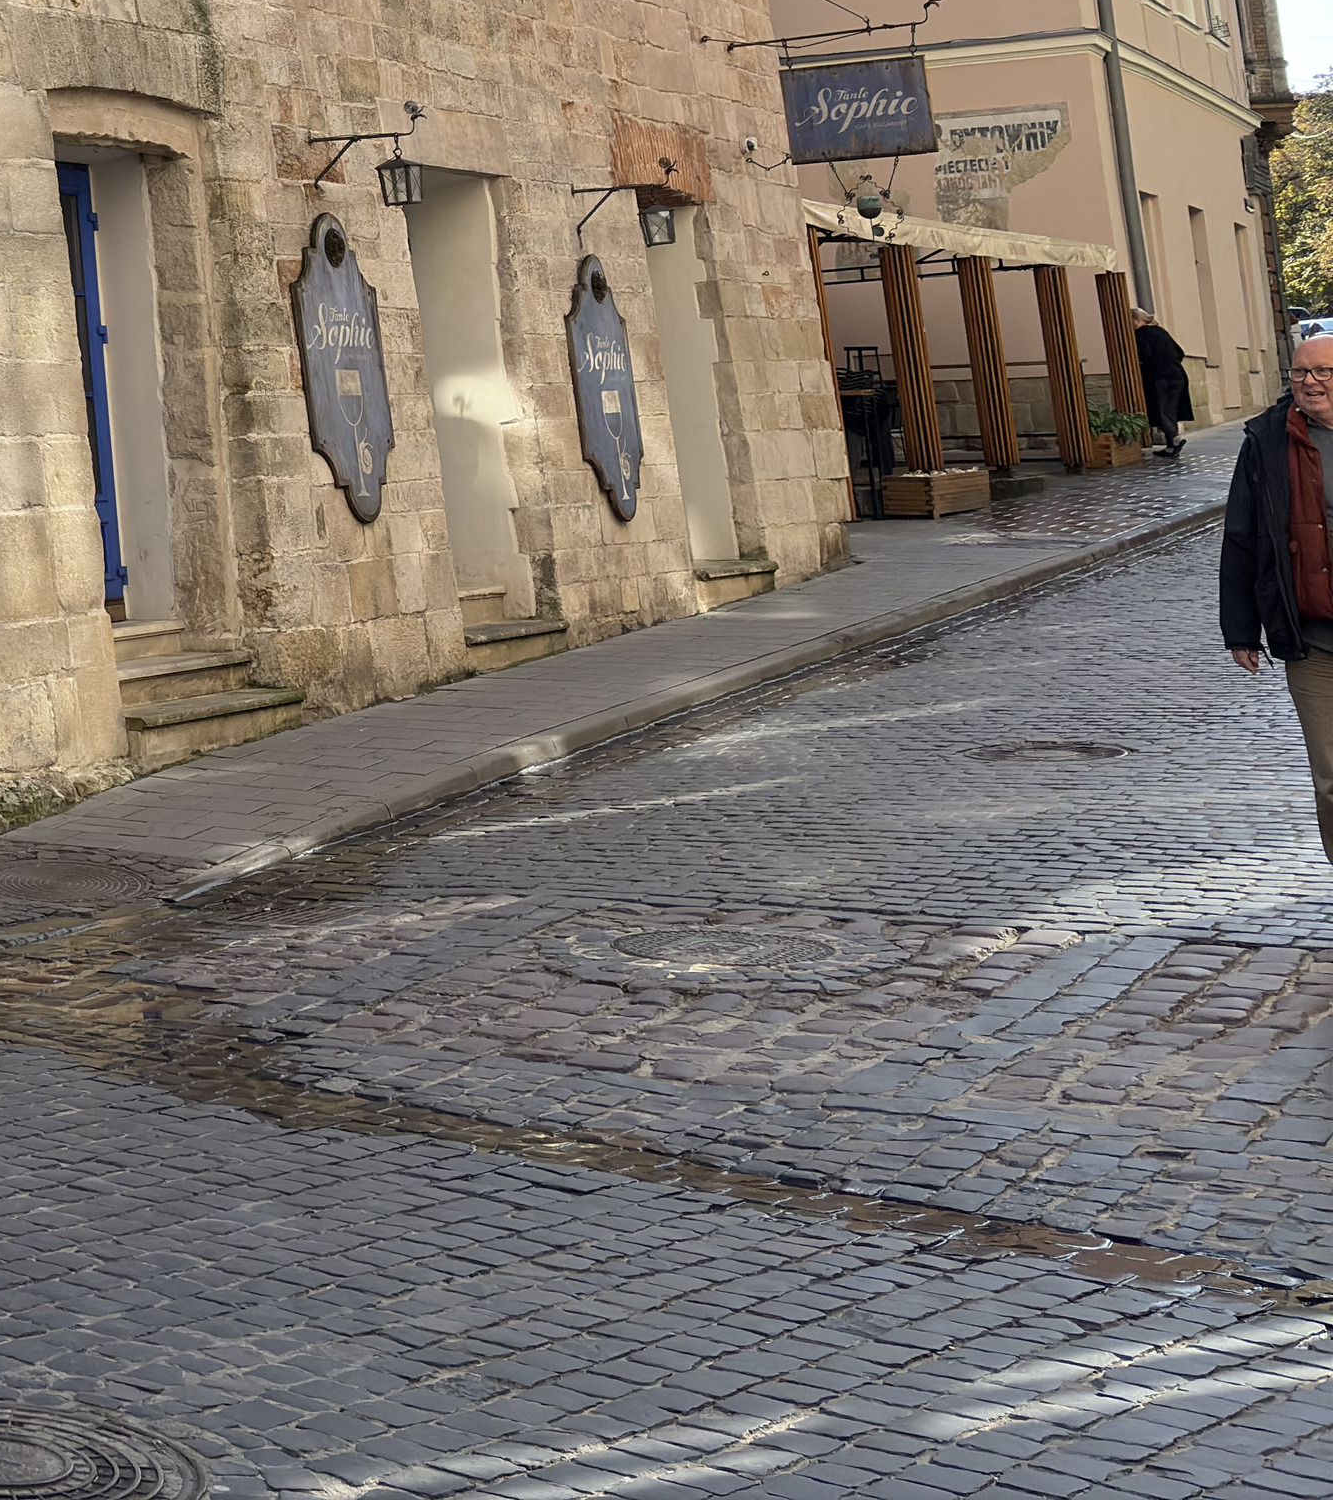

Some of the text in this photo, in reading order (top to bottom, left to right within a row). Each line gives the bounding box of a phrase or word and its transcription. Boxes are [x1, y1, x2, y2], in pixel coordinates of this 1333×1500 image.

[795, 87, 918, 134] Sophie
[307, 303, 374, 364] Sophie
[577, 332, 626, 385] Sophie
